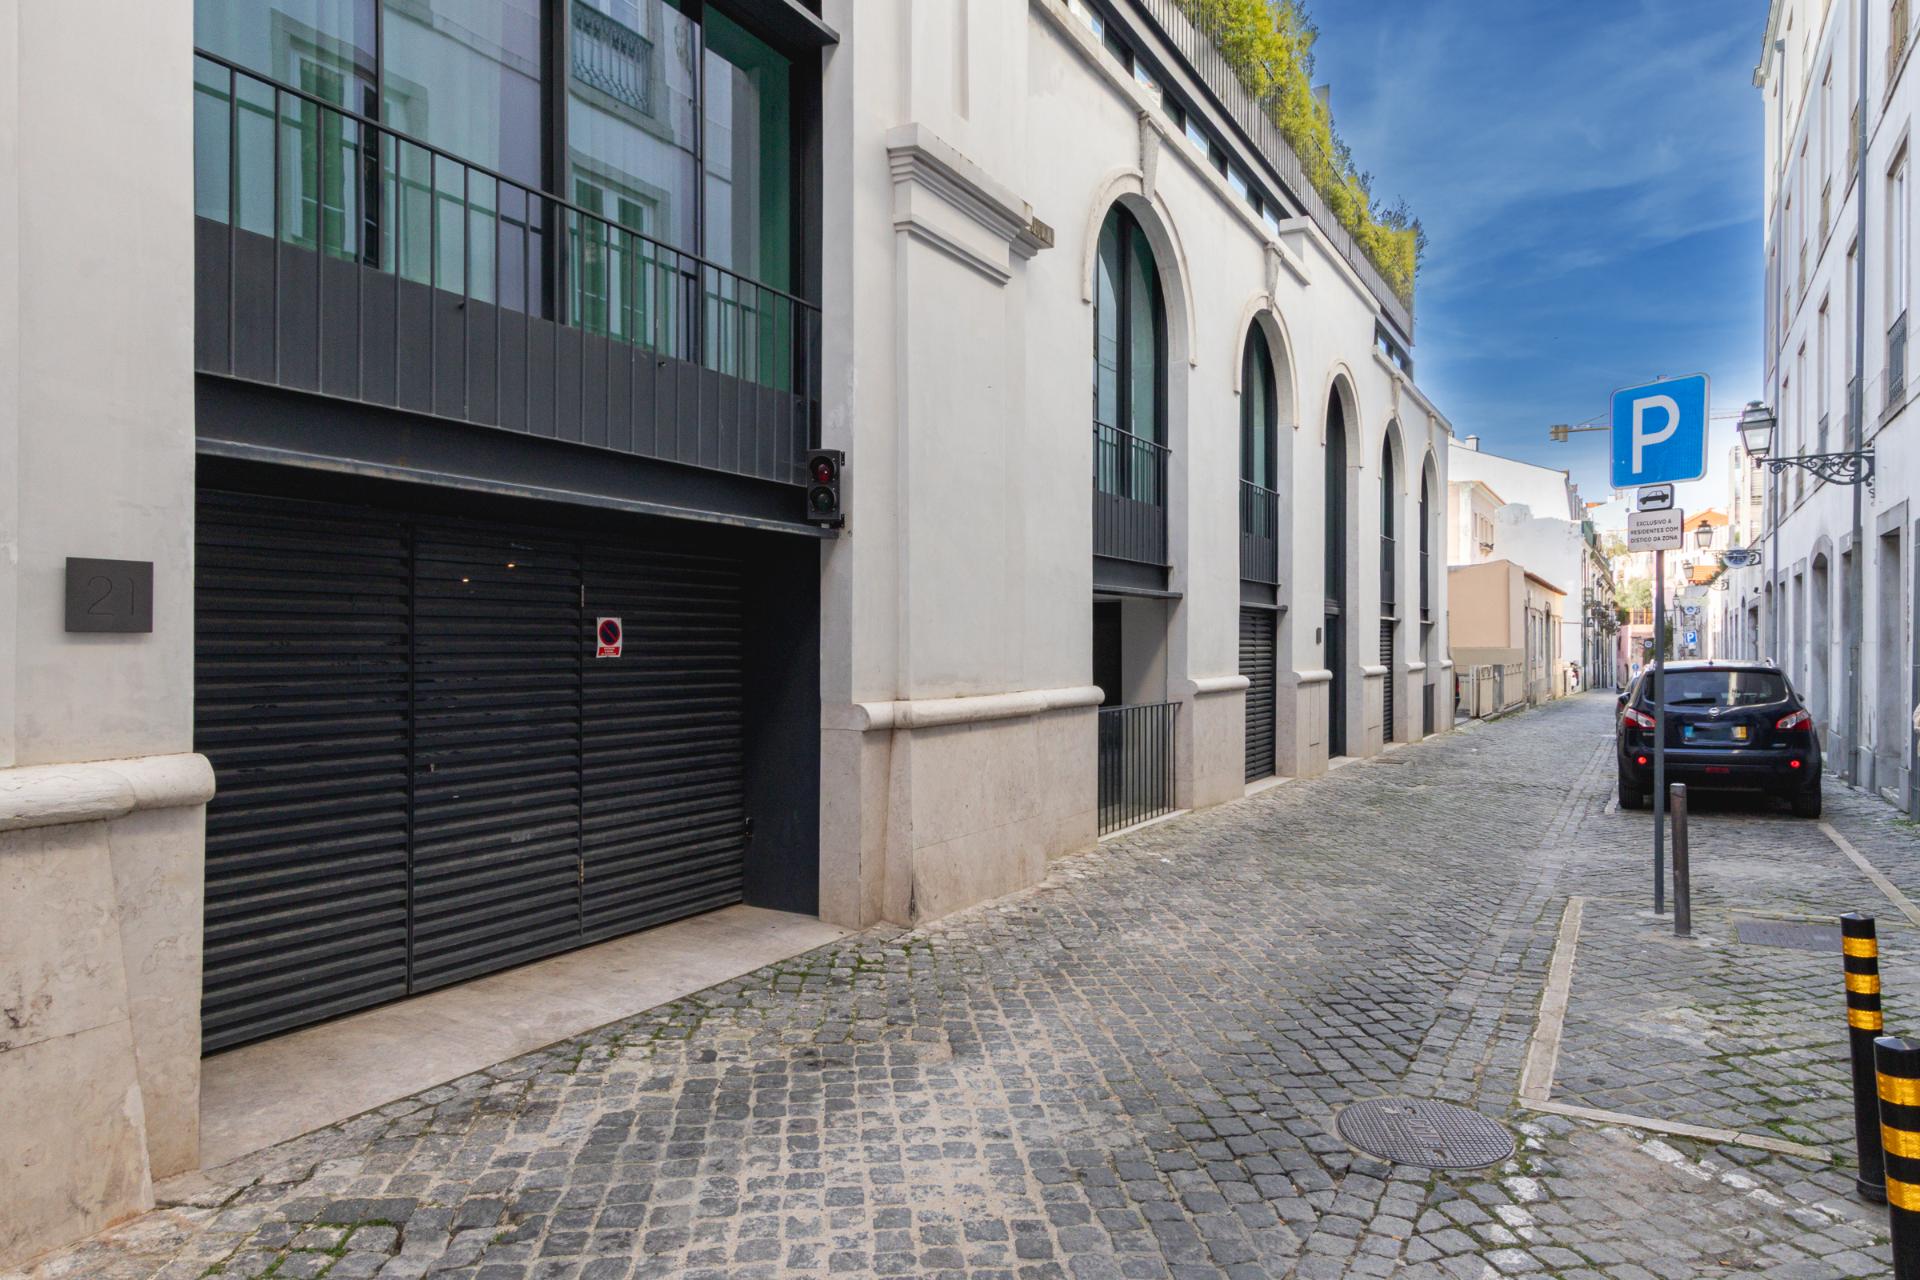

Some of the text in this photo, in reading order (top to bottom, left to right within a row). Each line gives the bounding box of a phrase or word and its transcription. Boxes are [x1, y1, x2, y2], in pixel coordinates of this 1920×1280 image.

[1632, 394, 1680, 474] P
[1636, 519, 1667, 527] EXCLUSIVO
[1630, 527, 1664, 535] RESIDENTES
[87, 575, 135, 616] 21
[1687, 632, 1694, 643] P
